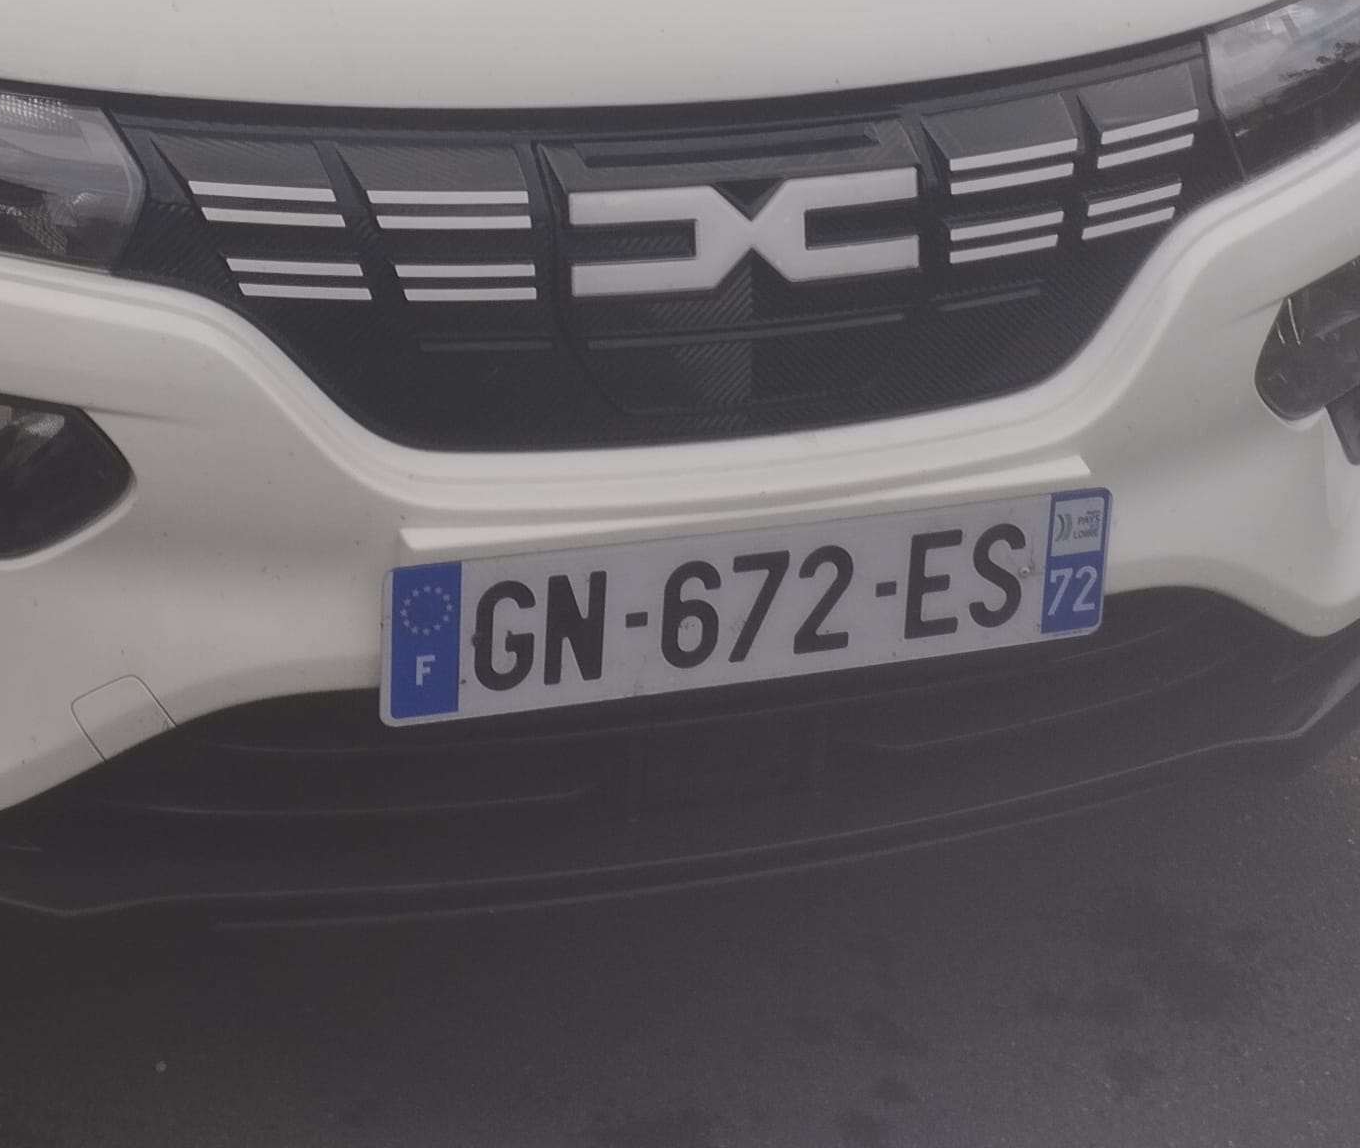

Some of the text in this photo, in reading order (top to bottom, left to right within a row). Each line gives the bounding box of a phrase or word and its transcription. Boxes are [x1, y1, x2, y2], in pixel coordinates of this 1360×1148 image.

[474, 523, 1027, 691] GN-672-ES
[1047, 565, 1098, 616] 72
[415, 654, 436, 686] F
